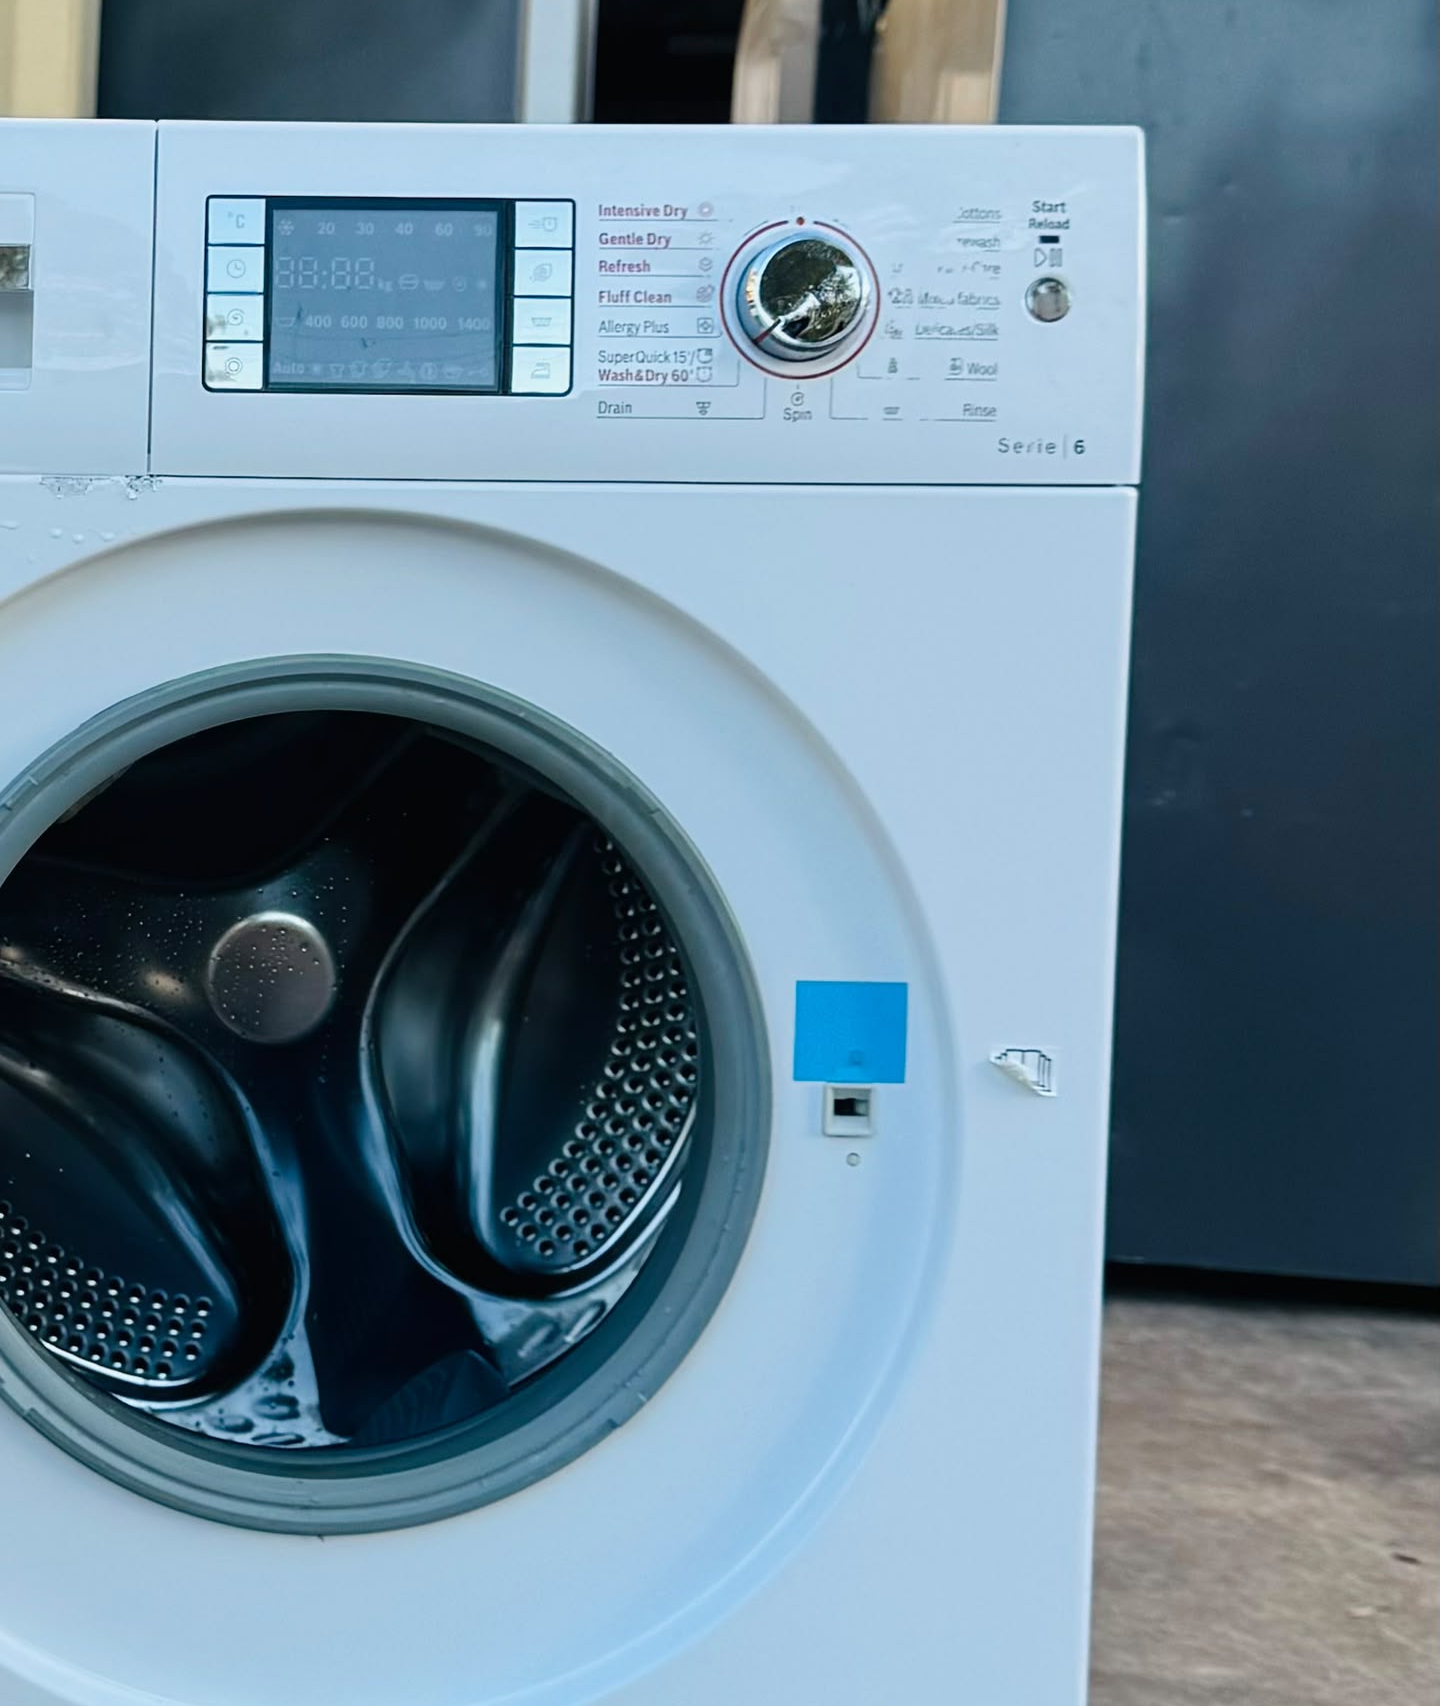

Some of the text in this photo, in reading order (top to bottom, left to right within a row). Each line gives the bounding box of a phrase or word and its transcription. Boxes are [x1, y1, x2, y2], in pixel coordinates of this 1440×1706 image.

[598, 204, 688, 220] Intensive Dry
[957, 207, 1002, 219] ottons
[1032, 200, 1066, 213] Start
[317, 222, 336, 236] 20
[356, 222, 375, 236] 30
[395, 222, 414, 236] 40
[435, 223, 454, 237] 60
[1028, 218, 1070, 230] Reload
[598, 233, 672, 248] Gentle Dry
[598, 260, 651, 273] Refresh
[598, 290, 672, 303] Fluff Clean
[305, 315, 491, 331] 400 600 800 1000 1400
[598, 320, 670, 336] Allergy Plus
[598, 350, 671, 367] SuperQuick
[273, 362, 305, 376] Auto
[966, 361, 998, 376] Wool
[598, 369, 669, 384] Wash&Dry
[597, 401, 633, 414] Drain
[962, 403, 997, 417] Rinse
[782, 408, 812, 422] Spin
[997, 438, 1086, 455] Serie 6
